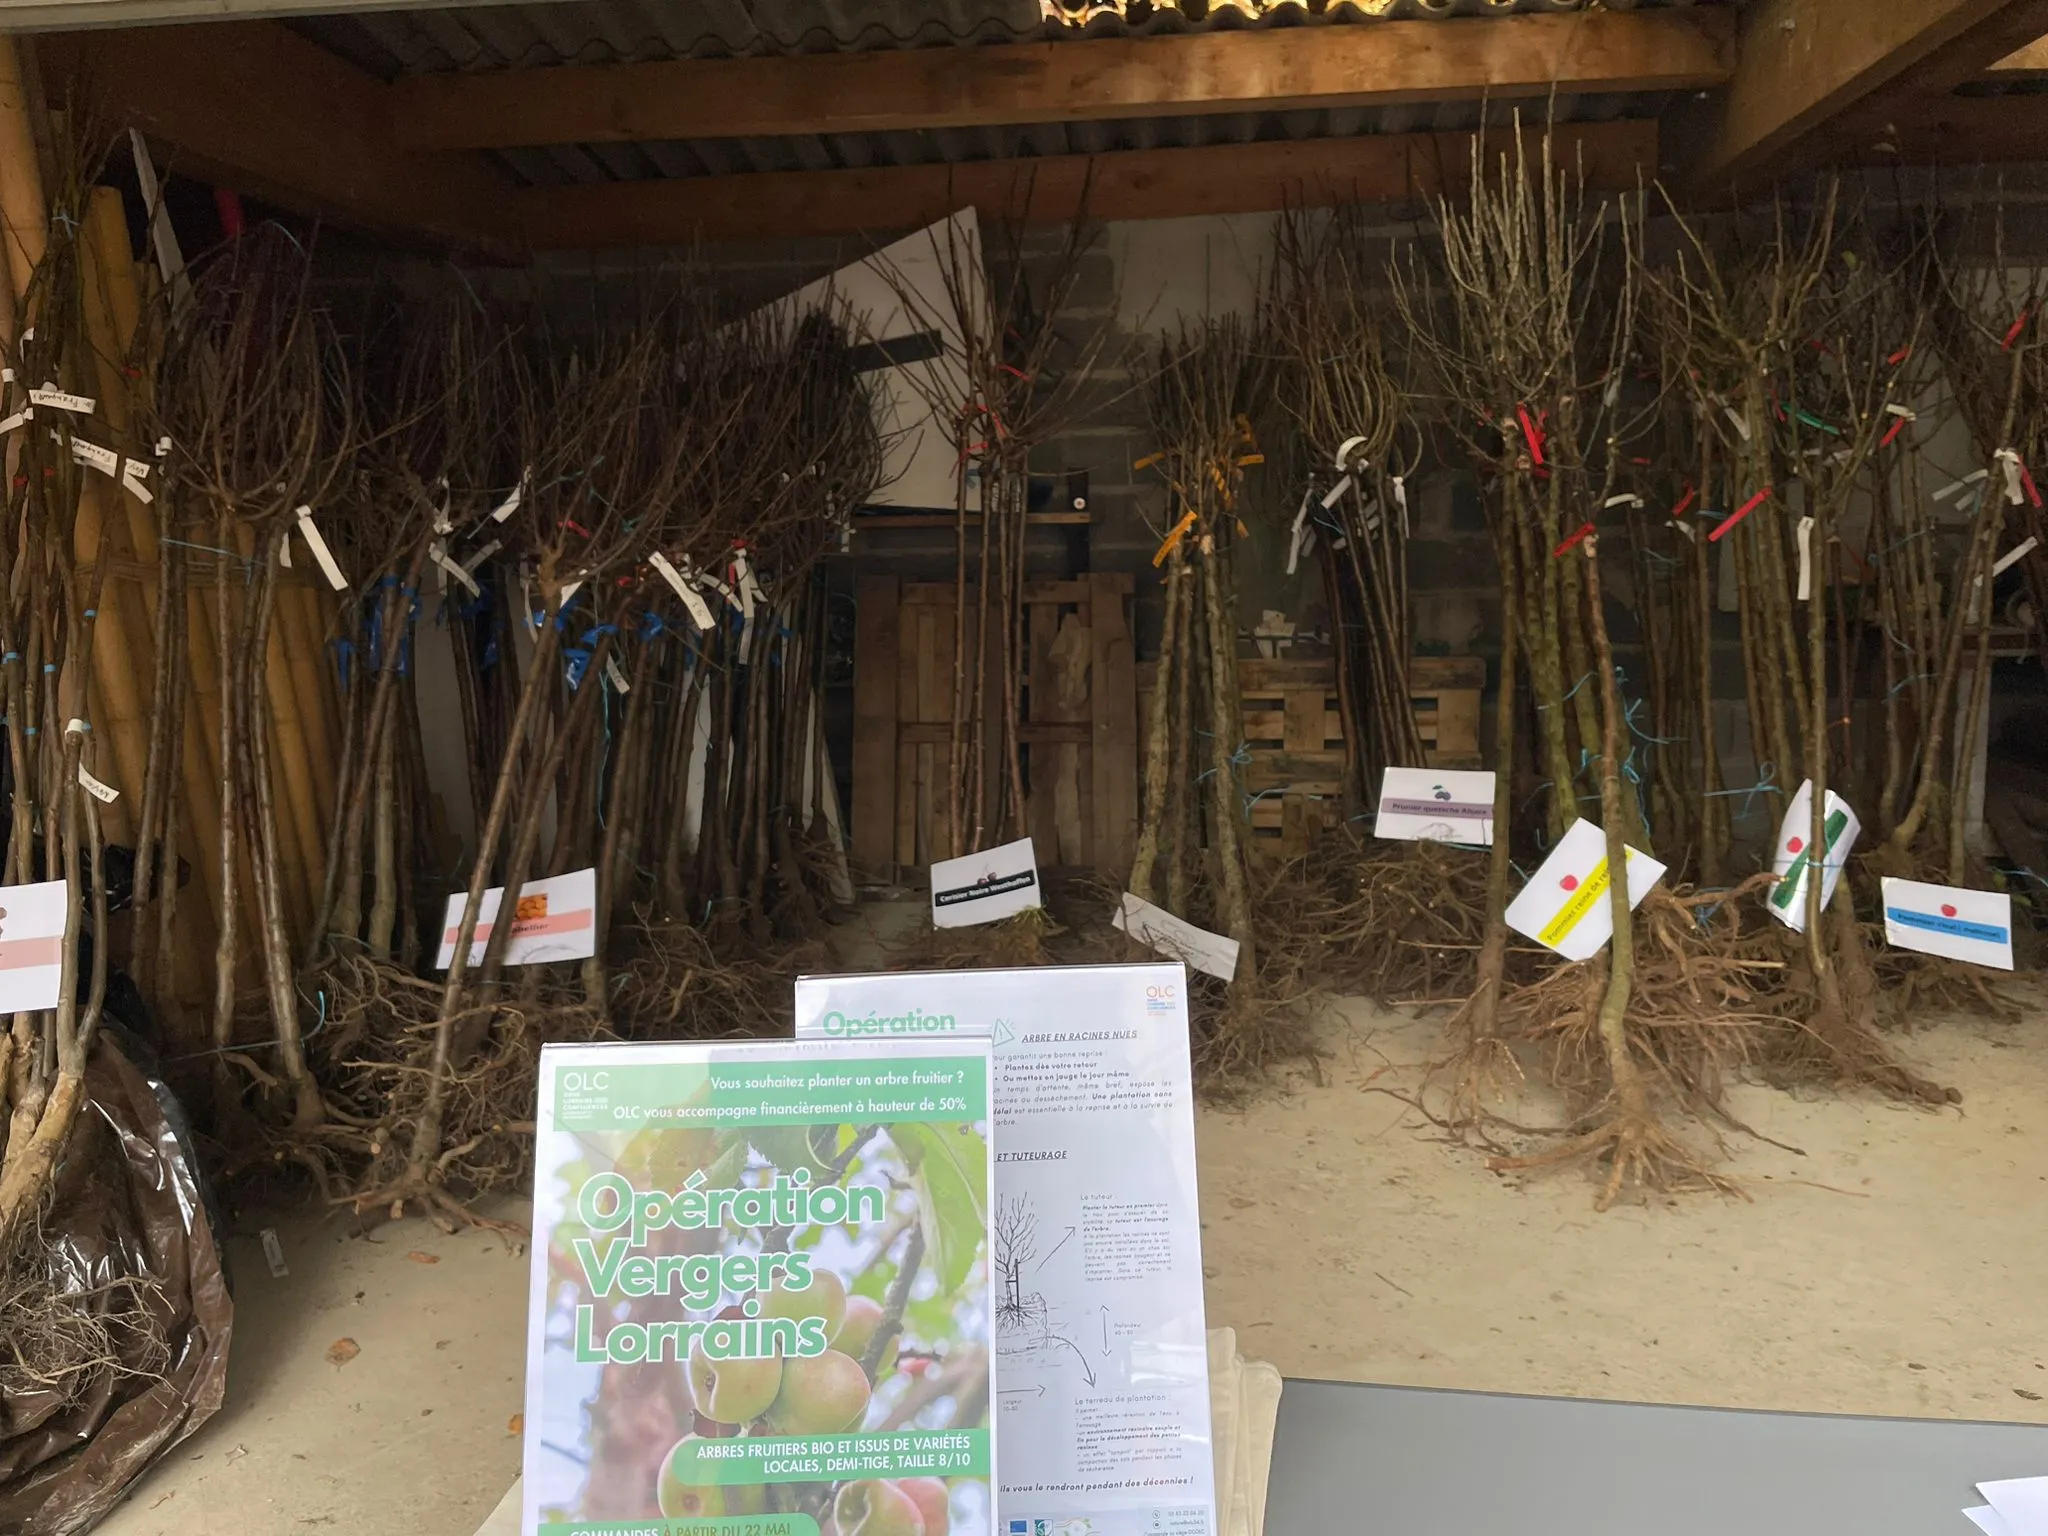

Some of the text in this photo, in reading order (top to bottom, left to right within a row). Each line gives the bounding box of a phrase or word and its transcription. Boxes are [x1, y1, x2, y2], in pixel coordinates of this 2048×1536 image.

[1146, 984, 1176, 998] OLC
[823, 1007, 955, 1037] Opération
[1021, 1029, 1138, 1043] ARBRE EN RACINES NUES
[1004, 1063, 1034, 1071] Plantez
[563, 1071, 610, 1092] OLC
[711, 1070, 964, 1091] Vous souhaitez planter un arbre fruitier ?
[1056, 1072, 1078, 1082] jauge
[1080, 1071, 1087, 1079] le
[1089, 1071, 1105, 1080] jour
[1106, 1070, 1130, 1078] même
[1110, 1091, 1151, 1100] plantation
[613, 1097, 967, 1120] OLC vous accompagne financièrement à hauteur de 50%
[1027, 1105, 1066, 1114] essentielle
[996, 1150, 1068, 1162] ET TUTEURAGE
[577, 1167, 886, 1248] Opération
[572, 1237, 814, 1313] Vergers
[575, 1298, 828, 1364] Lorrains
[1127, 1394, 1166, 1403] plantation
[697, 1432, 971, 1459] ARBRES FRUITIERS BIO ET ISSUS DE VARIÉTÉS
[764, 1452, 971, 1475] LOCALES, DEMI-TIGE, TAILLE 8/10
[1012, 1485, 1033, 1493] vous
[1035, 1483, 1043, 1491] le
[1046, 1482, 1084, 1492] rendront
[1085, 1481, 1123, 1492] pendant
[1125, 1479, 1141, 1488] des
[1143, 1477, 1187, 1487] décennies
[722, 1526, 741, 1536] DU
[745, 1525, 762, 1536] 22
[765, 1523, 790, 1535] MAI
